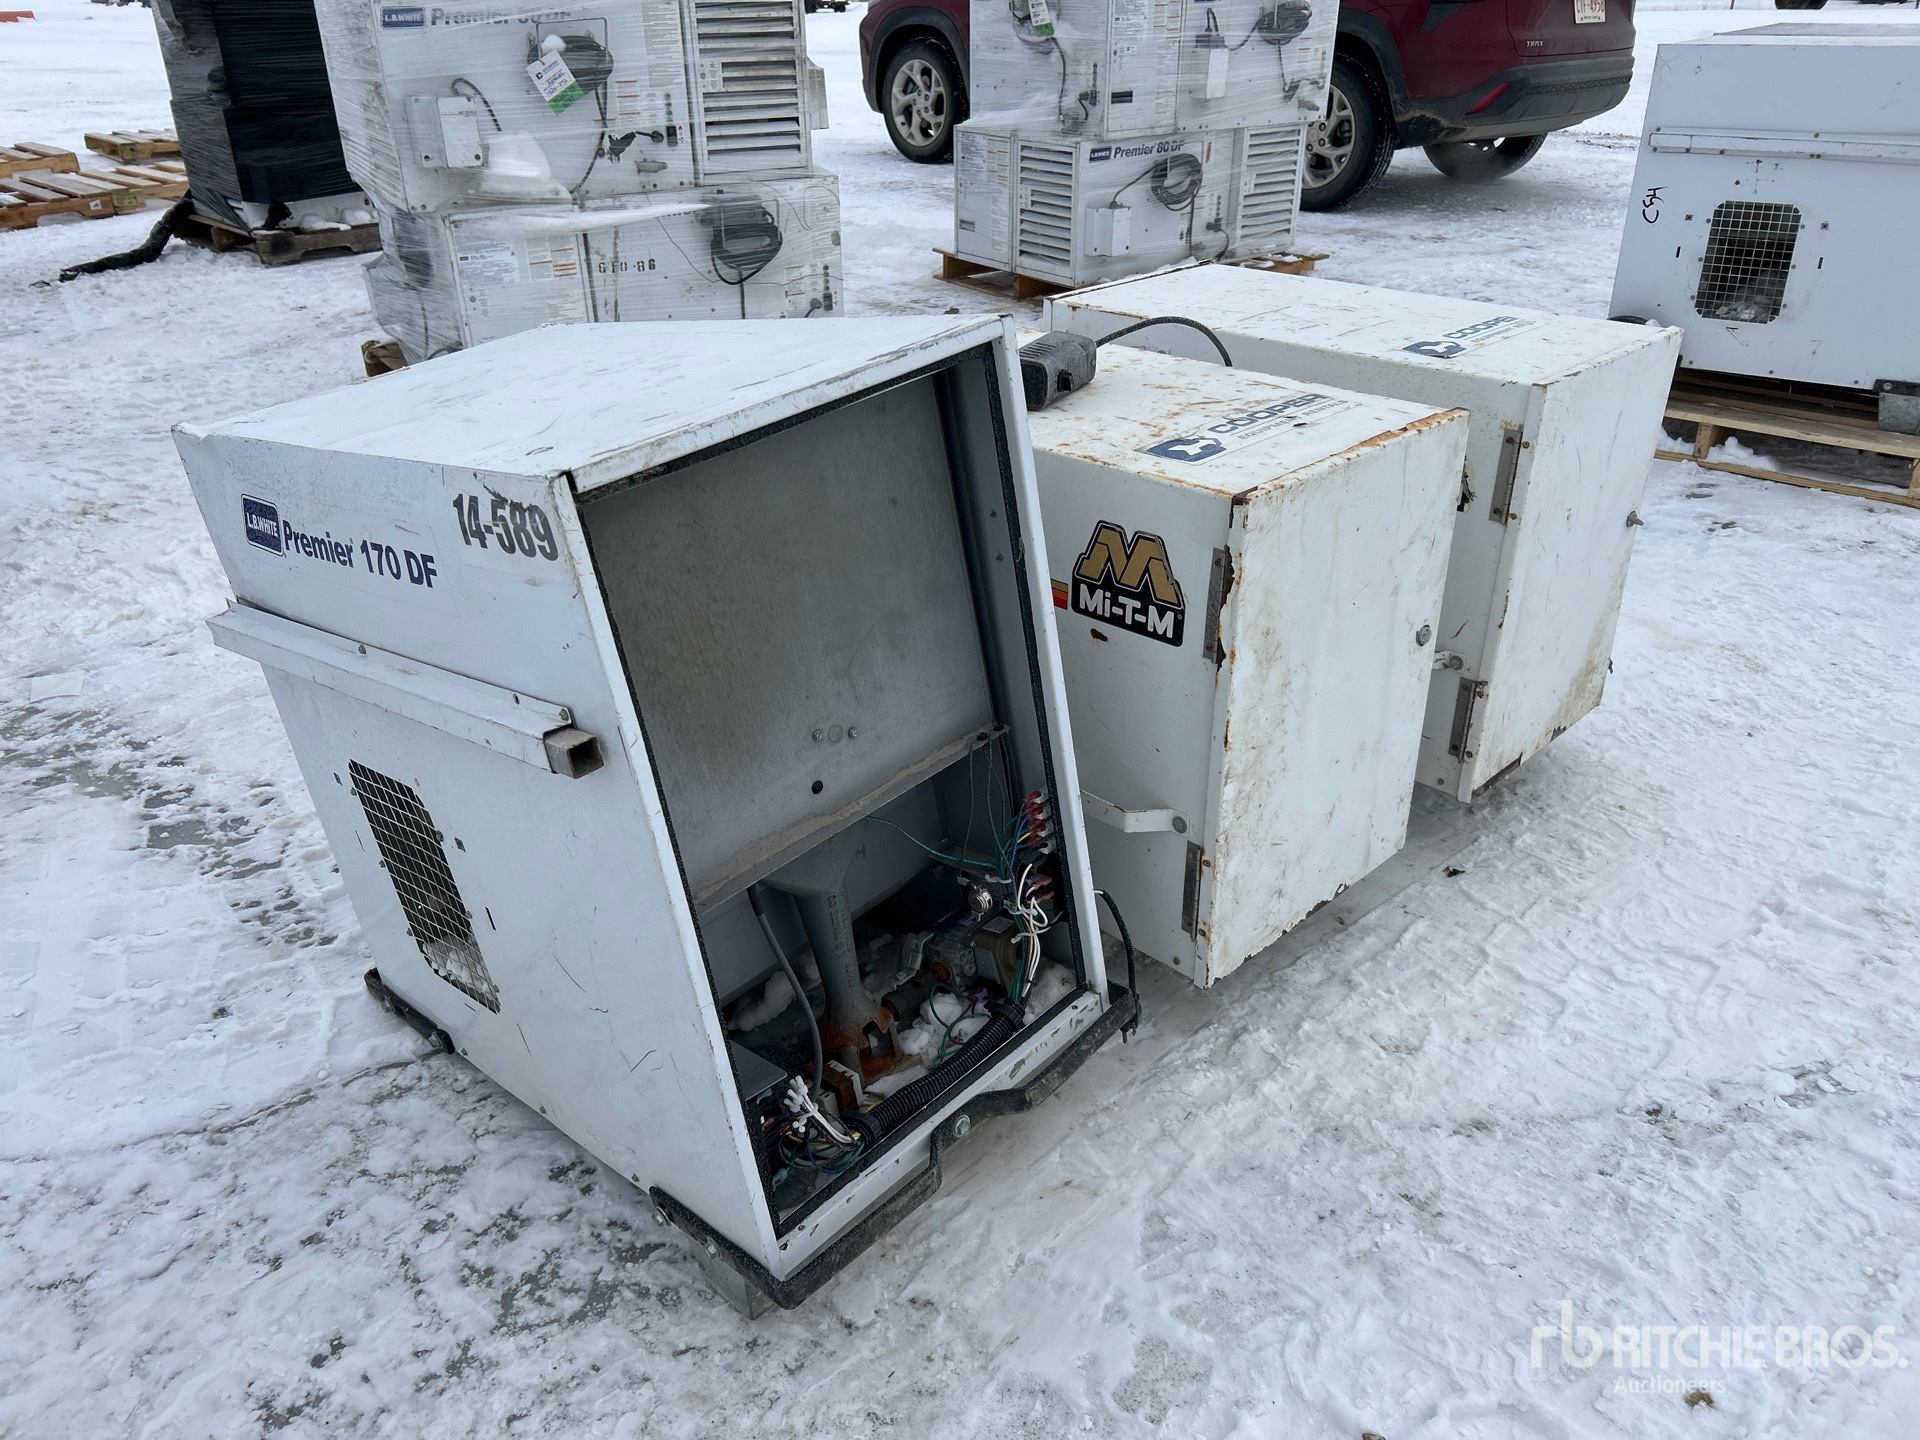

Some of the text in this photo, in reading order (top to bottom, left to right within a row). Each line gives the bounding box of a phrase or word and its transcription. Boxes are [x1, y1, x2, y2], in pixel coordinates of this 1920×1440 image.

[1113, 144, 1156, 158] Premier
[1157, 141, 1169, 153] 80
[1442, 315, 1519, 339] COOPE
[1207, 393, 1329, 434] COOPER
[1302, 400, 1349, 417] RENTALS
[245, 511, 279, 539] L.B.WHITE
[452, 493, 559, 562] 14-589
[282, 519, 438, 589] Premier 170 DF
[1079, 583, 1175, 639] Mi-T-M
